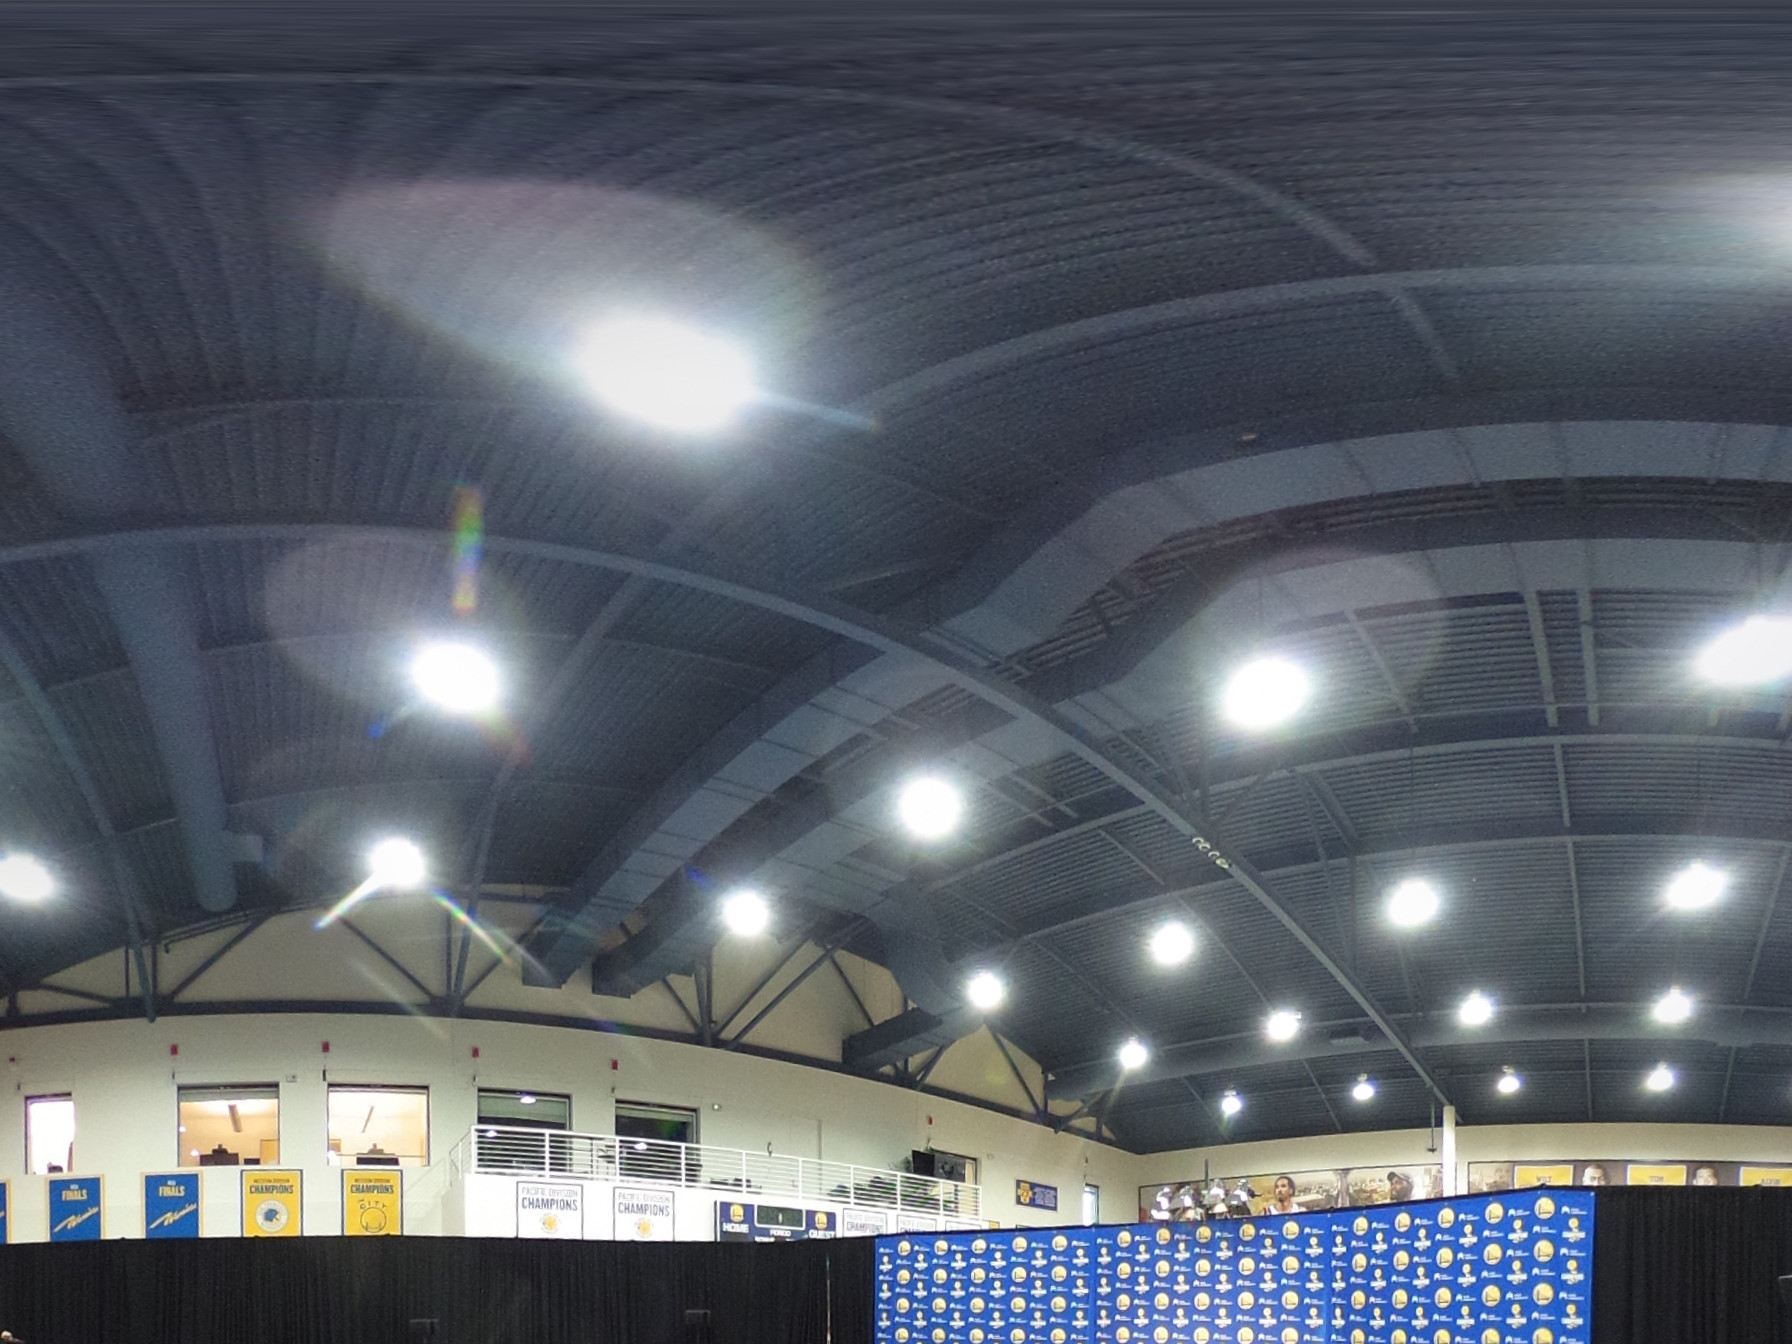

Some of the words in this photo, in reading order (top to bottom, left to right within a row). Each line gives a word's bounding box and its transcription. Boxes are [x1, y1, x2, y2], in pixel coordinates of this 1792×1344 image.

[62, 1189, 88, 1201] FINALS
[159, 1185, 186, 1197] FINALS
[249, 1184, 294, 1195] CHAMPIONS
[350, 1184, 395, 1195] CHAMPIONS
[521, 1197, 578, 1212] CHAMPIONS
[618, 1202, 670, 1217] CHAMPIONS
[722, 1222, 750, 1233] HOME
[808, 1229, 836, 1239] GUEST
